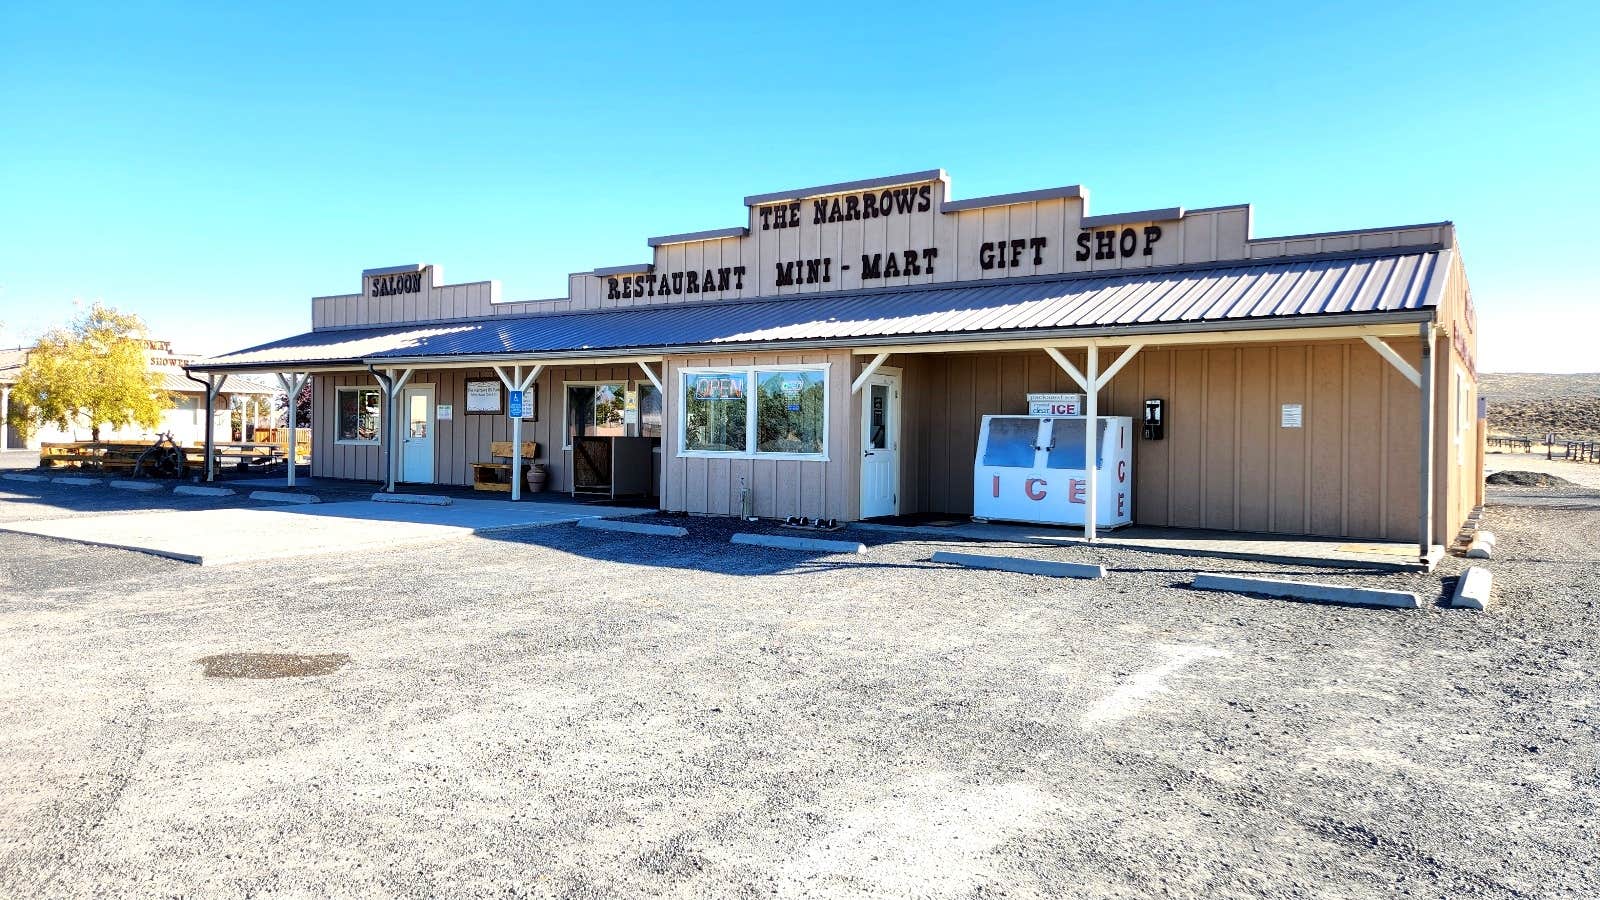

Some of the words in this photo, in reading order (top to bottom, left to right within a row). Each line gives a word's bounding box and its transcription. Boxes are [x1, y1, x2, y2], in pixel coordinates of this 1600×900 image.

[760, 203, 800, 230] THE
[814, 186, 931, 225] NARROWS
[980, 237, 1046, 270] GIFT
[1076, 226, 1162, 261] SHOP
[608, 266, 746, 299] RESTAURANT
[776, 258, 831, 286] MINI
[861, 248, 937, 279] MART
[372, 273, 422, 297] SALOON
[1051, 404, 1076, 415] ICE
[1117, 426, 1126, 517] ICE
[992, 475, 1086, 504] ICE
